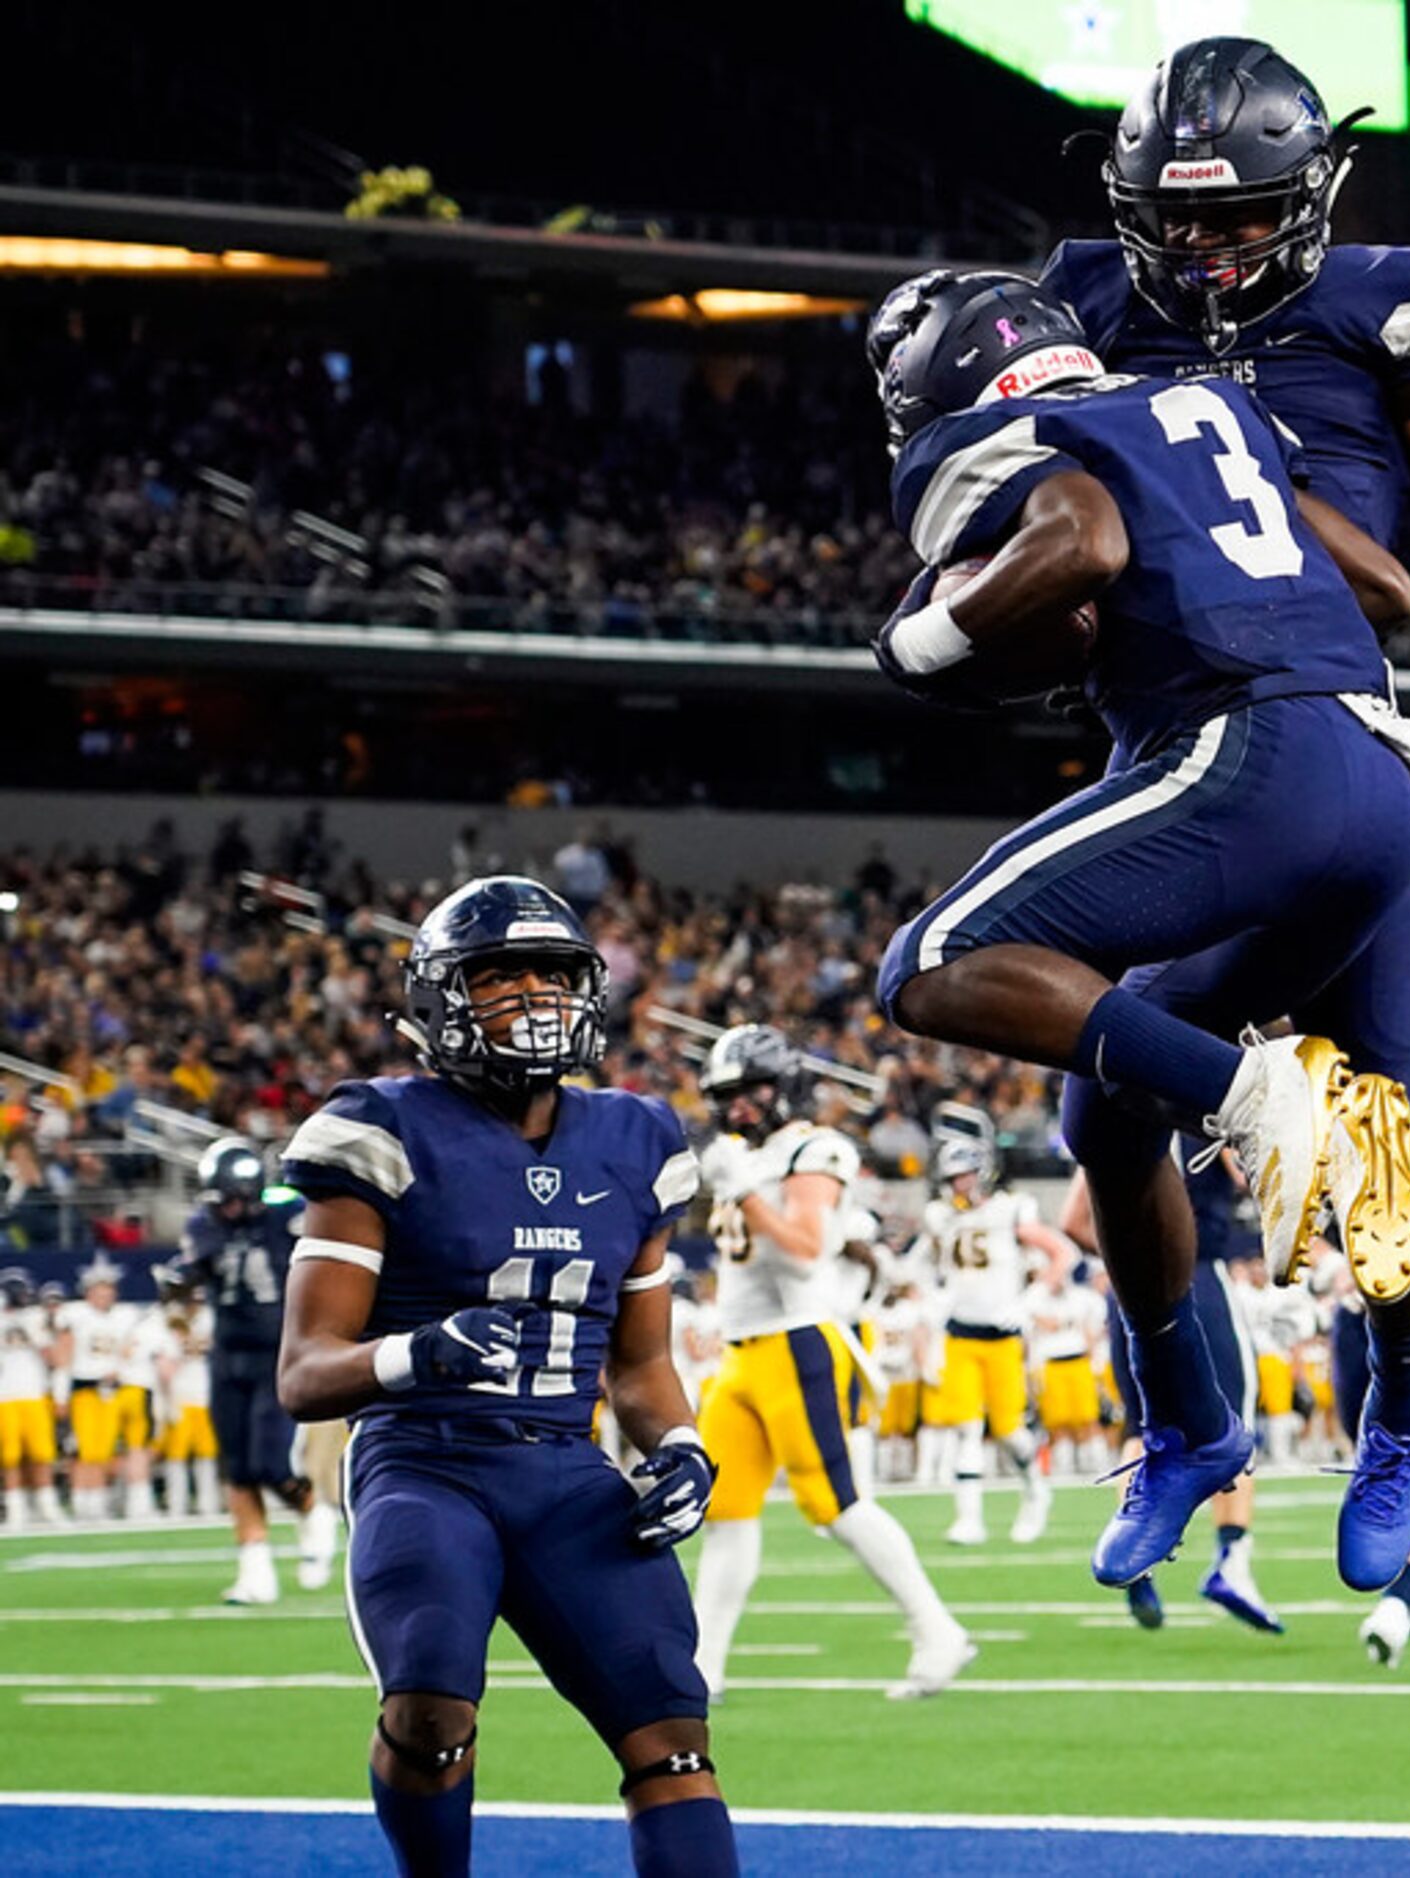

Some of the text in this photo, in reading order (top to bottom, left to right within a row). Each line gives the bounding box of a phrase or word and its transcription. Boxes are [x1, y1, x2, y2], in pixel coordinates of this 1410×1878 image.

[1168, 164, 1223, 179] Riddell
[997, 349, 1094, 397] Riddell
[1150, 384, 1303, 578] 3
[514, 1227, 582, 1250] RANGERS
[467, 1257, 595, 1397] 11
